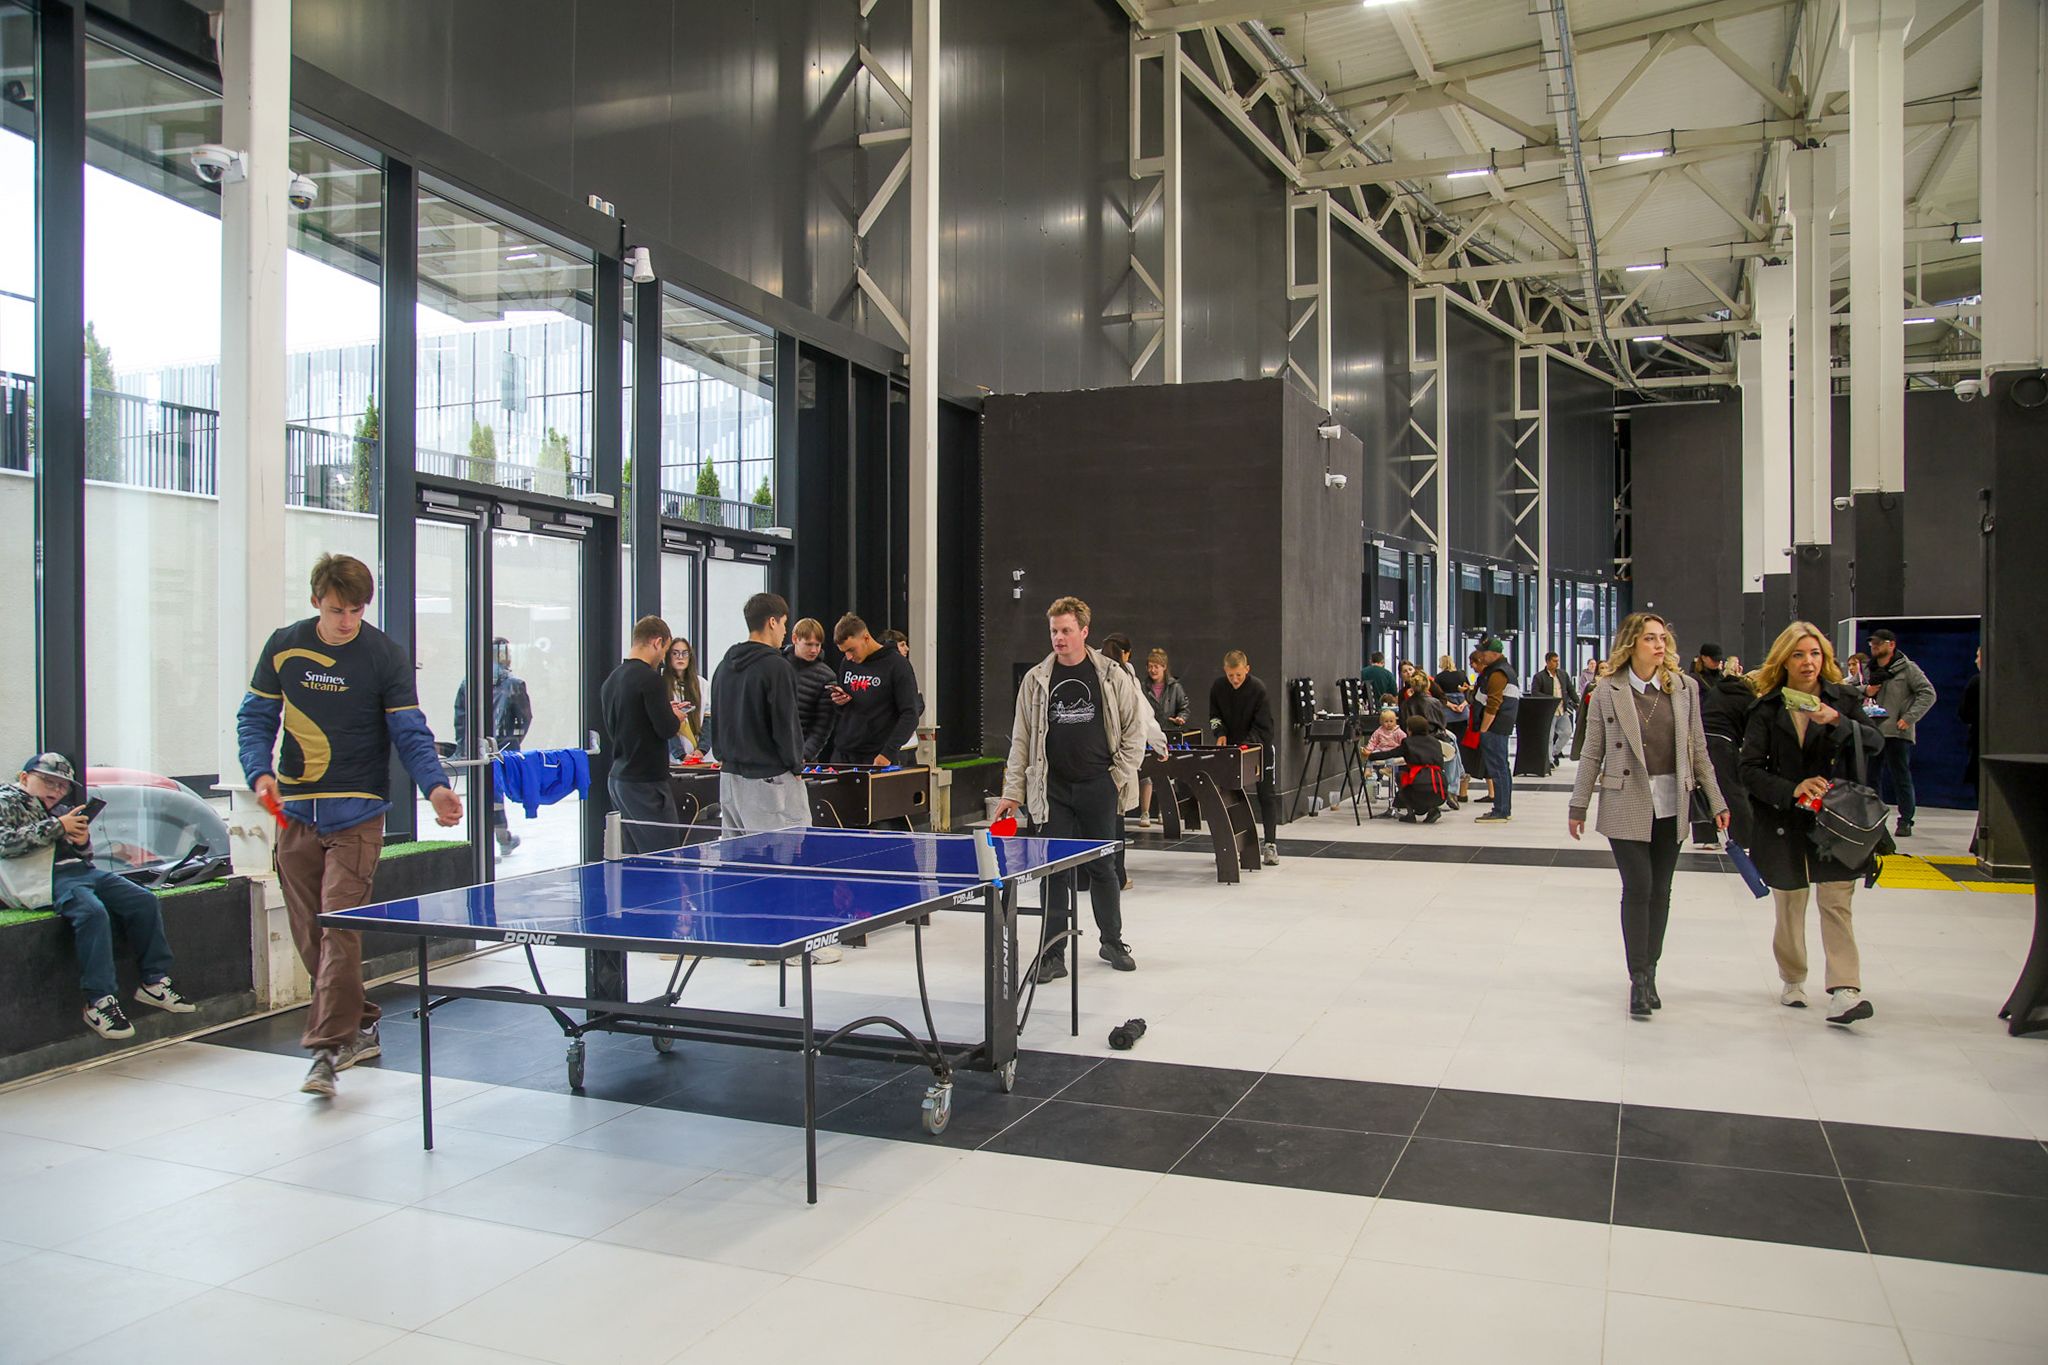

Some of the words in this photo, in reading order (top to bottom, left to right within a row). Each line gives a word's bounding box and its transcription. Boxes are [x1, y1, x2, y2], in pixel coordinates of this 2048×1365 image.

[305, 670, 345, 685] Sminex
[310, 681, 338, 692] team
[503, 931, 557, 945] DONIC
[804, 931, 839, 953] DONIC
